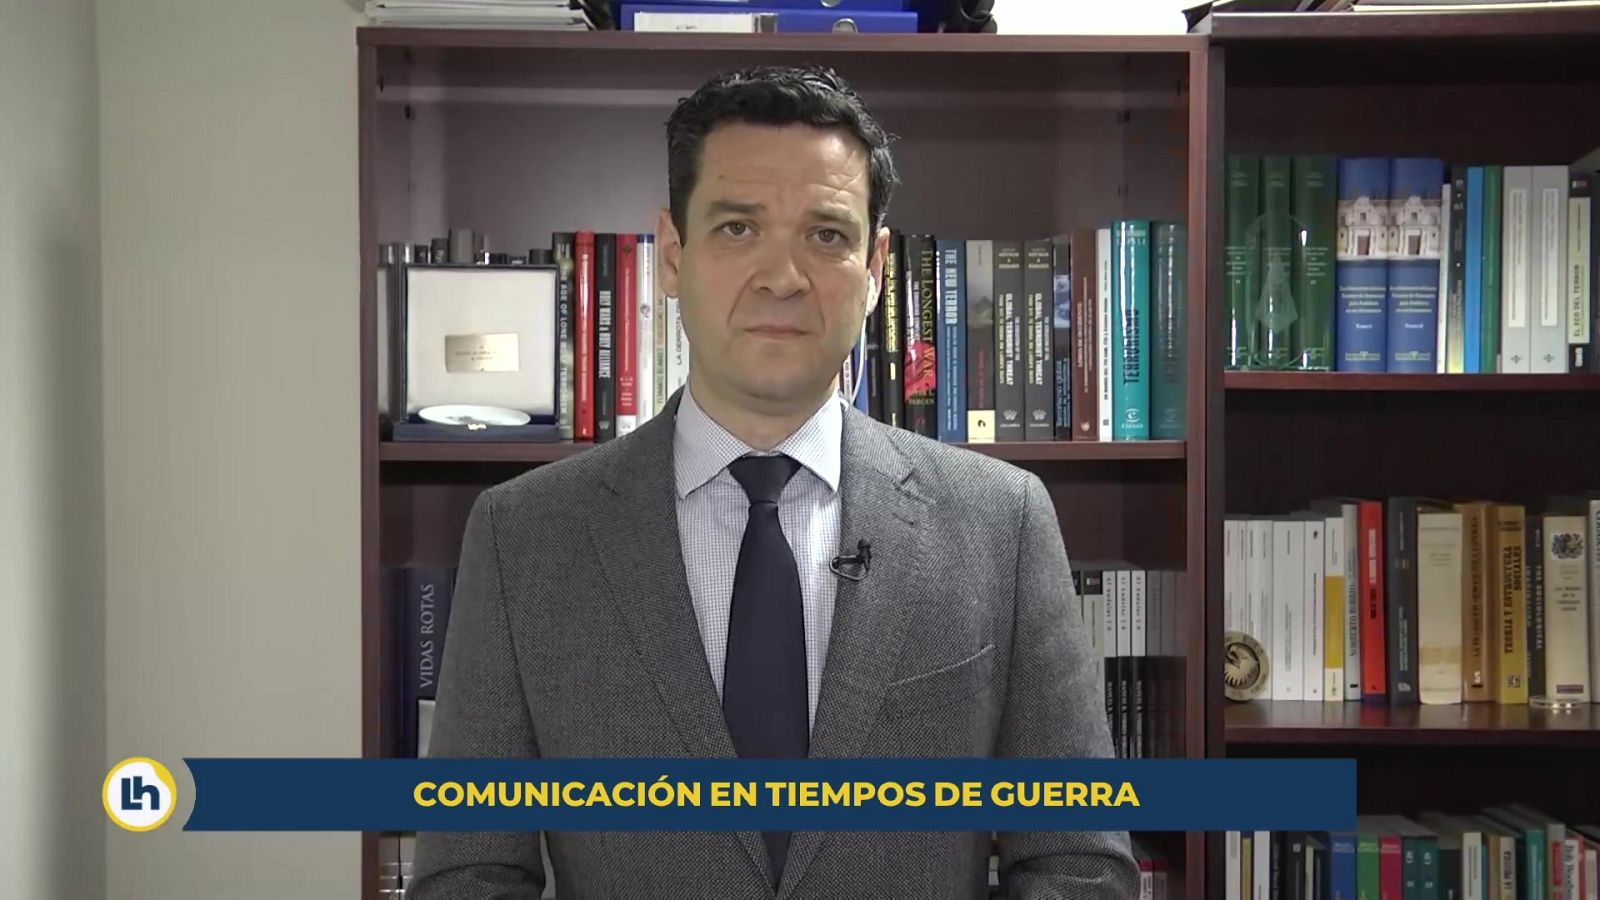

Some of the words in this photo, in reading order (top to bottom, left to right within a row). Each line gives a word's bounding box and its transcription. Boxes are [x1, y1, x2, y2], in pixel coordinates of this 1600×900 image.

[921, 249, 933, 275] THE
[945, 249, 957, 265] THE
[945, 268, 957, 288] NEW
[560, 284, 568, 301] AGE
[560, 303, 568, 315] OF
[921, 279, 933, 341] LONGEST
[945, 290, 957, 324] TERROR
[560, 317, 568, 337] LONE
[1573, 328, 1580, 337] EL
[1123, 309, 1139, 385] TERRORISMO
[599, 349, 611, 378] ALLIANCE
[922, 346, 934, 378] WAR
[420, 583, 434, 635] ROTAS
[420, 640, 434, 688] VIDAS
